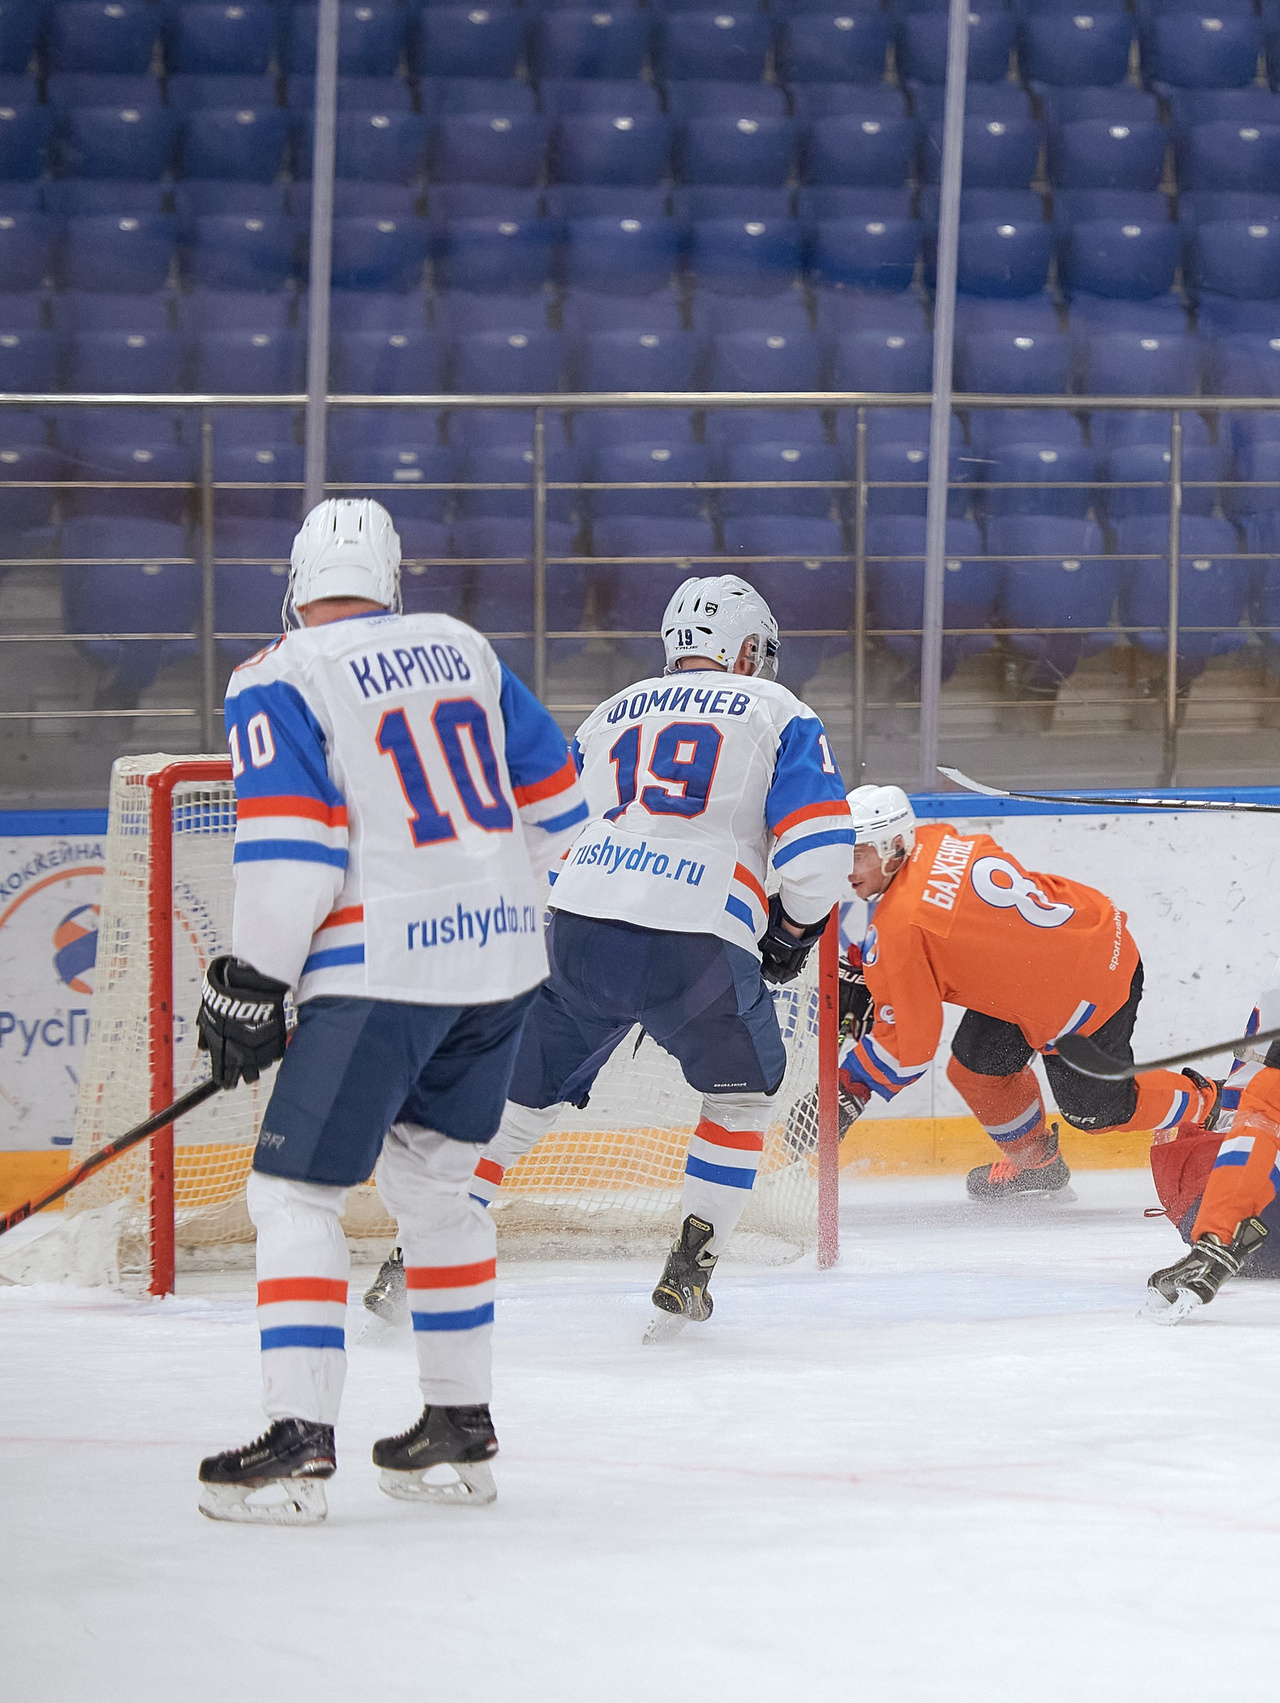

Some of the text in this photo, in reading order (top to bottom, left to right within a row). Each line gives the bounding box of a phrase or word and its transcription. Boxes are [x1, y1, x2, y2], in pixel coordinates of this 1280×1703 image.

[677, 628, 693, 646] 19
[350, 644, 471, 699] КАРПОВ
[607, 686, 751, 724] ФОМИЧЕВ
[227, 711, 276, 779] 10
[374, 696, 514, 848] 10
[603, 721, 724, 823] 19
[818, 733, 843, 775] 1
[0, 843, 106, 901] ХОККЕЙНА
[570, 835, 706, 886] rushydro.ru
[922, 833, 976, 911] БАЖЕНО
[970, 855, 1076, 928] 8
[406, 894, 538, 950] rushydro.ru
